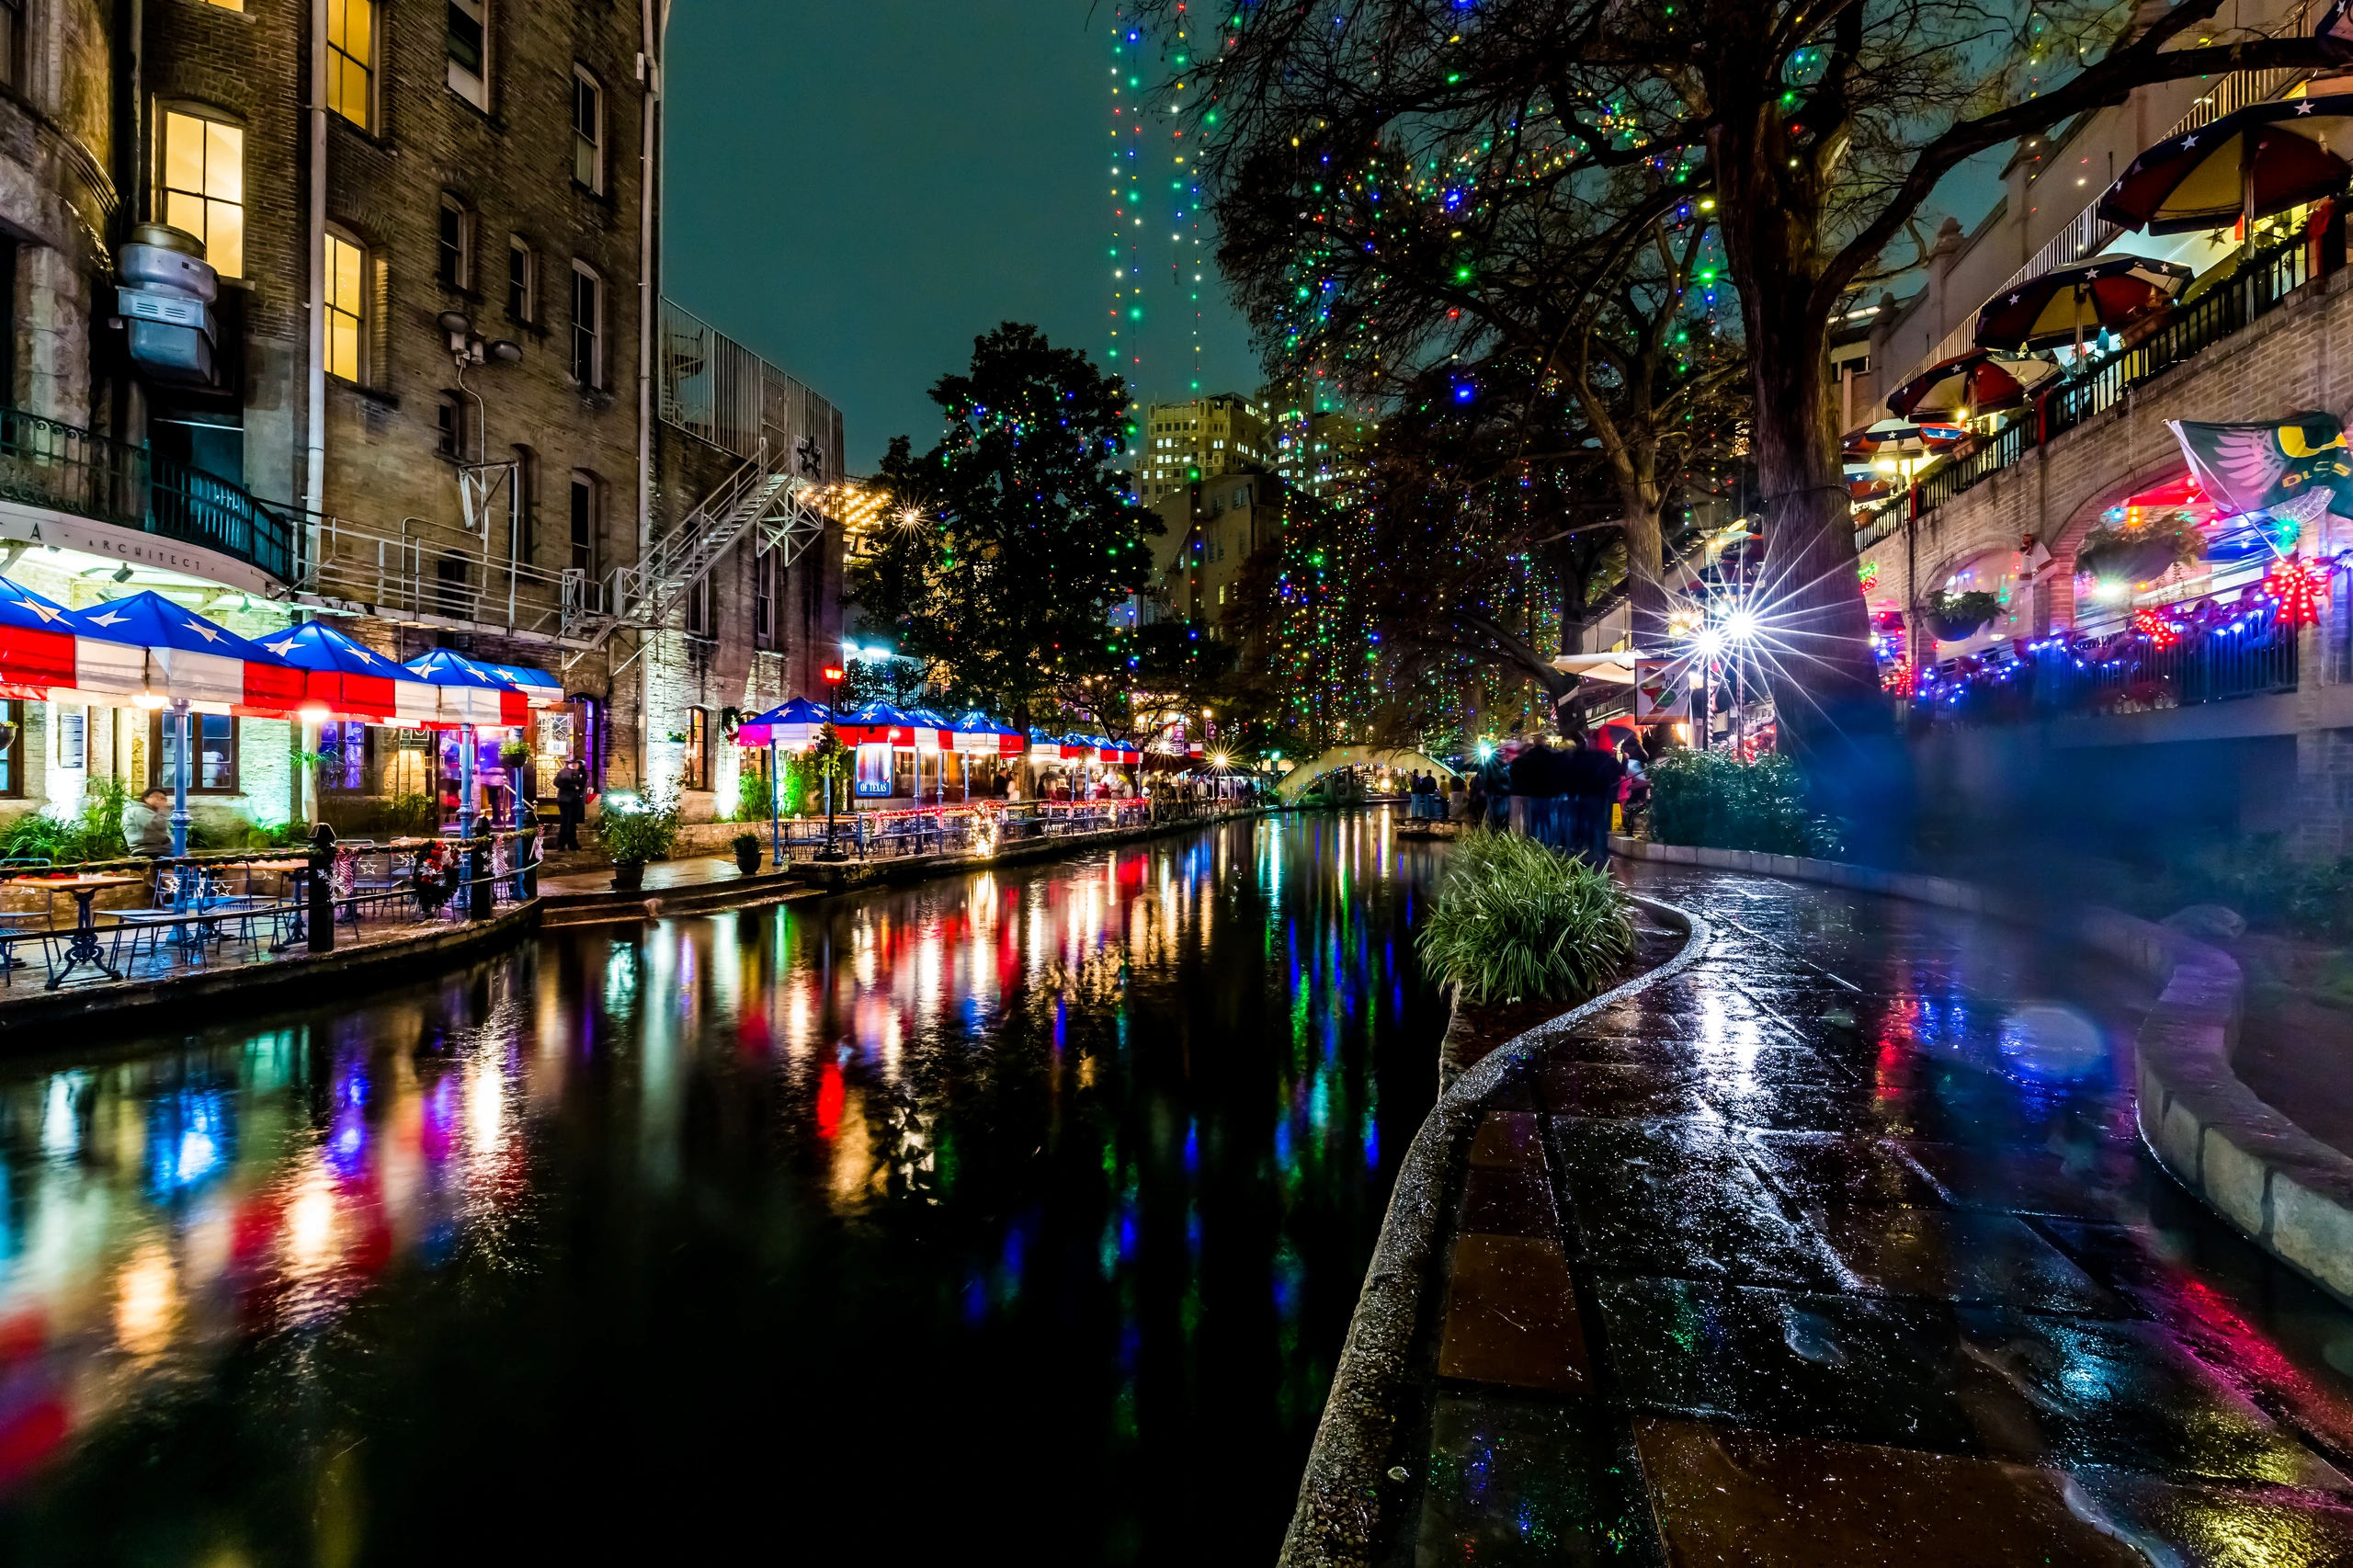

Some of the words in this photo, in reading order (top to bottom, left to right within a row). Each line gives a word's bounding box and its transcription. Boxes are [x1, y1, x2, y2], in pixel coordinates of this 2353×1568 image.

[2282, 460, 2351, 488] DCS
[860, 782, 868, 792] OF
[870, 782, 887, 792] TEXAS
